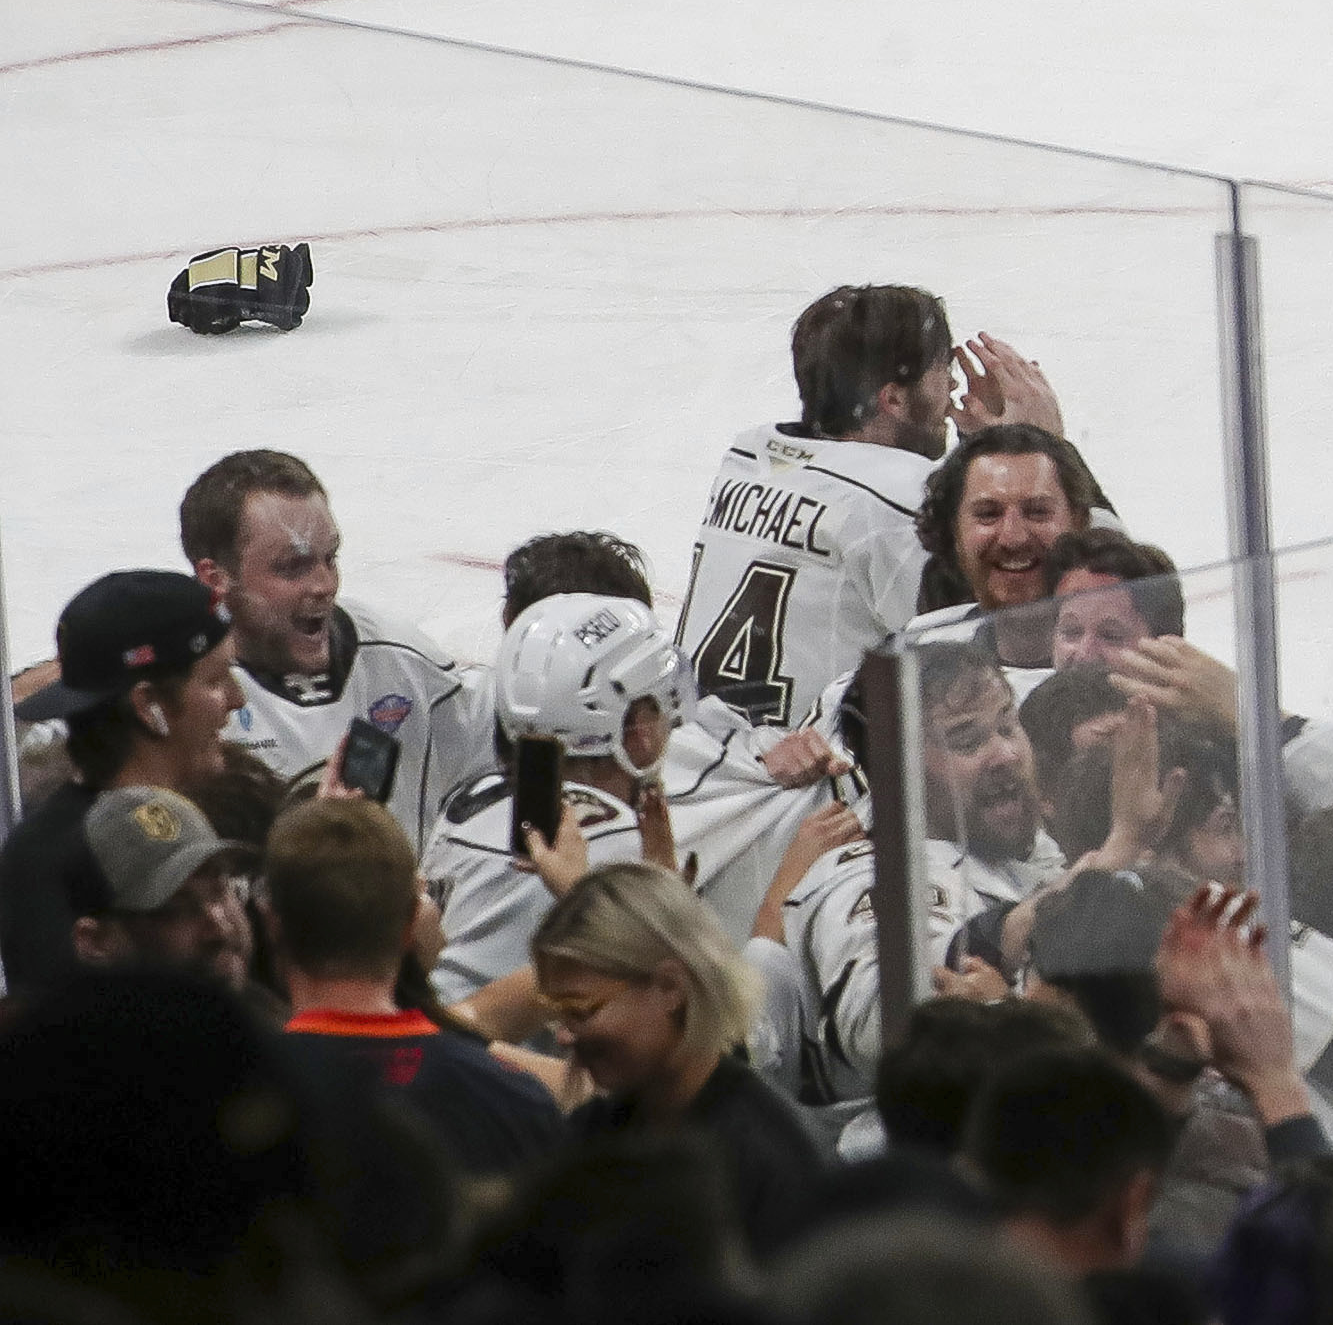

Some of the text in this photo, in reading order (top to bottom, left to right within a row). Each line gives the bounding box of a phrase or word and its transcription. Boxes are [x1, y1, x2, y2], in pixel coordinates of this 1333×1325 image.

[766, 439, 816, 462] CCM
[702, 479, 831, 557] MICHAEL
[672, 541, 800, 728] 4
